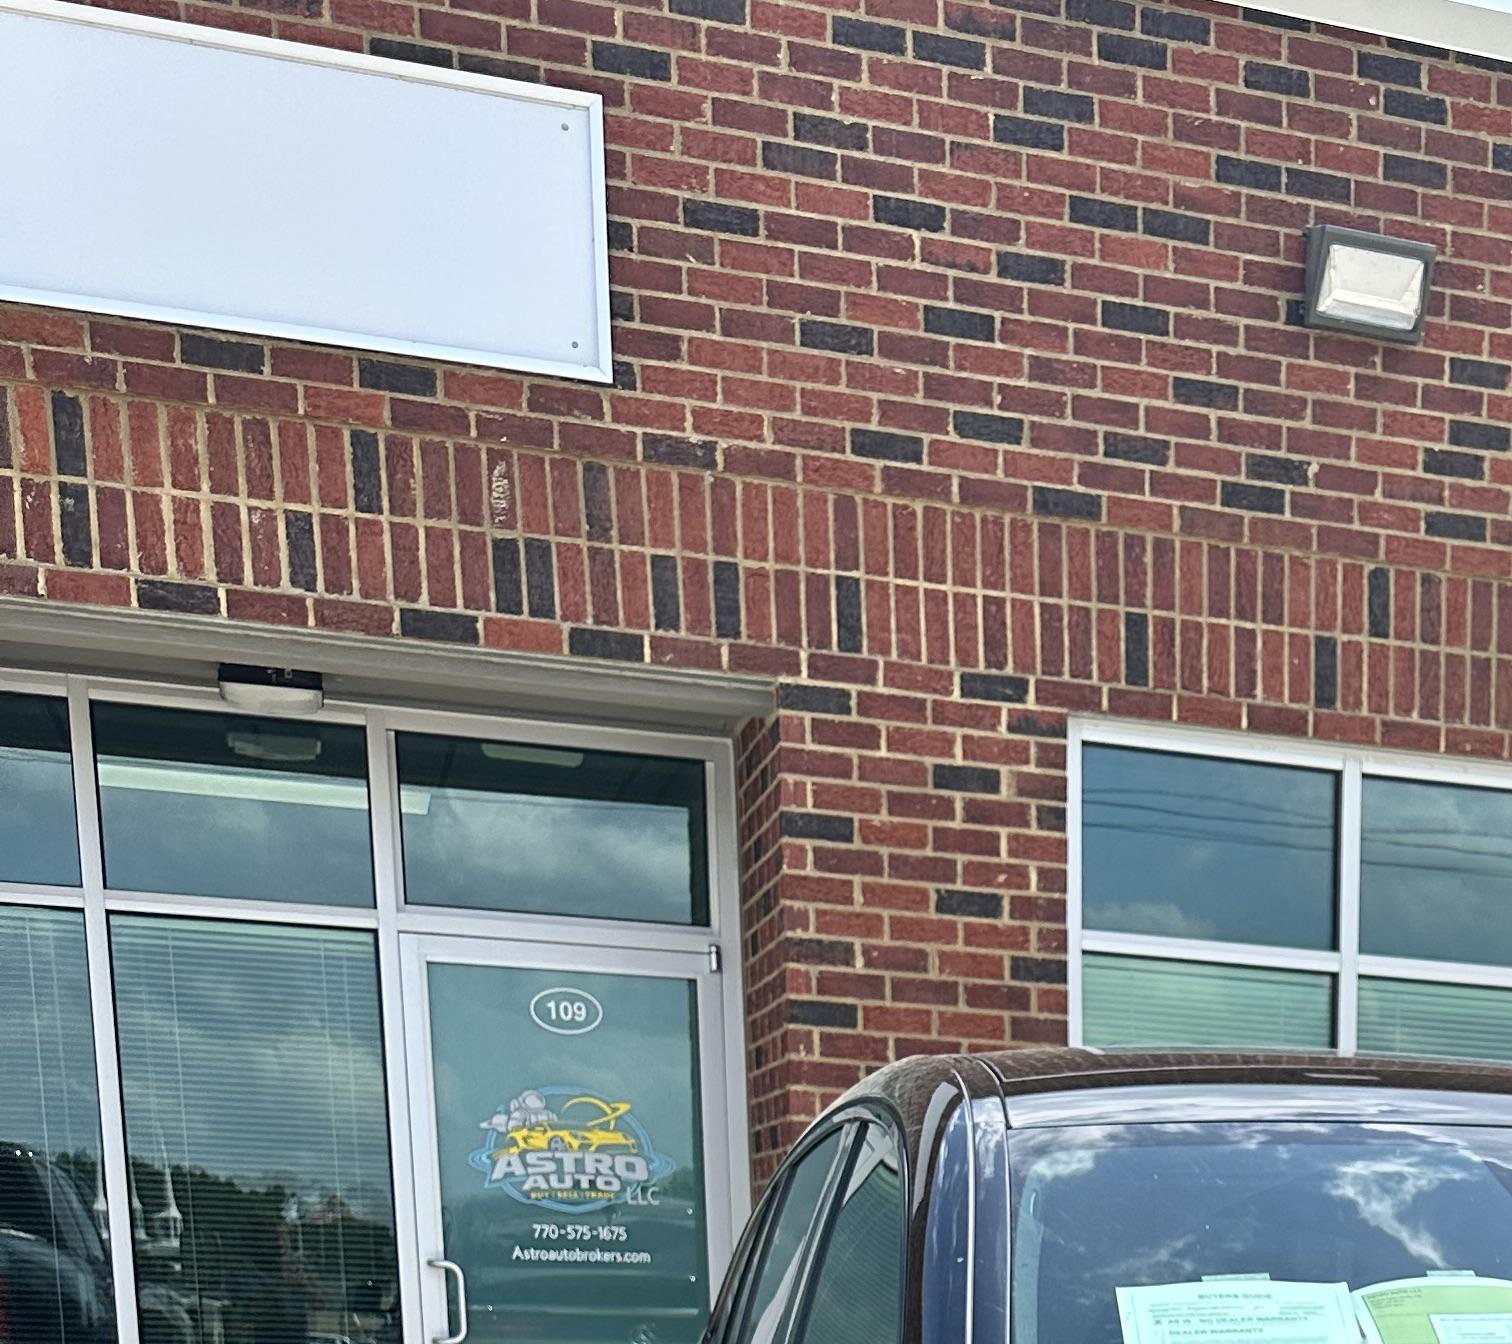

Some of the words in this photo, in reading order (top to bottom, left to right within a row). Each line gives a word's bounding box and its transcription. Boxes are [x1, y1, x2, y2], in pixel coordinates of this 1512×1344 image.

[546, 1001, 587, 1022] 109
[491, 1151, 649, 1181] ASTRO
[522, 1173, 621, 1191] AUTO
[626, 1187, 660, 1206] LLC
[532, 1223, 628, 1241] 770-575-1675
[512, 1245, 652, 1263] Astroautobrokers.com
